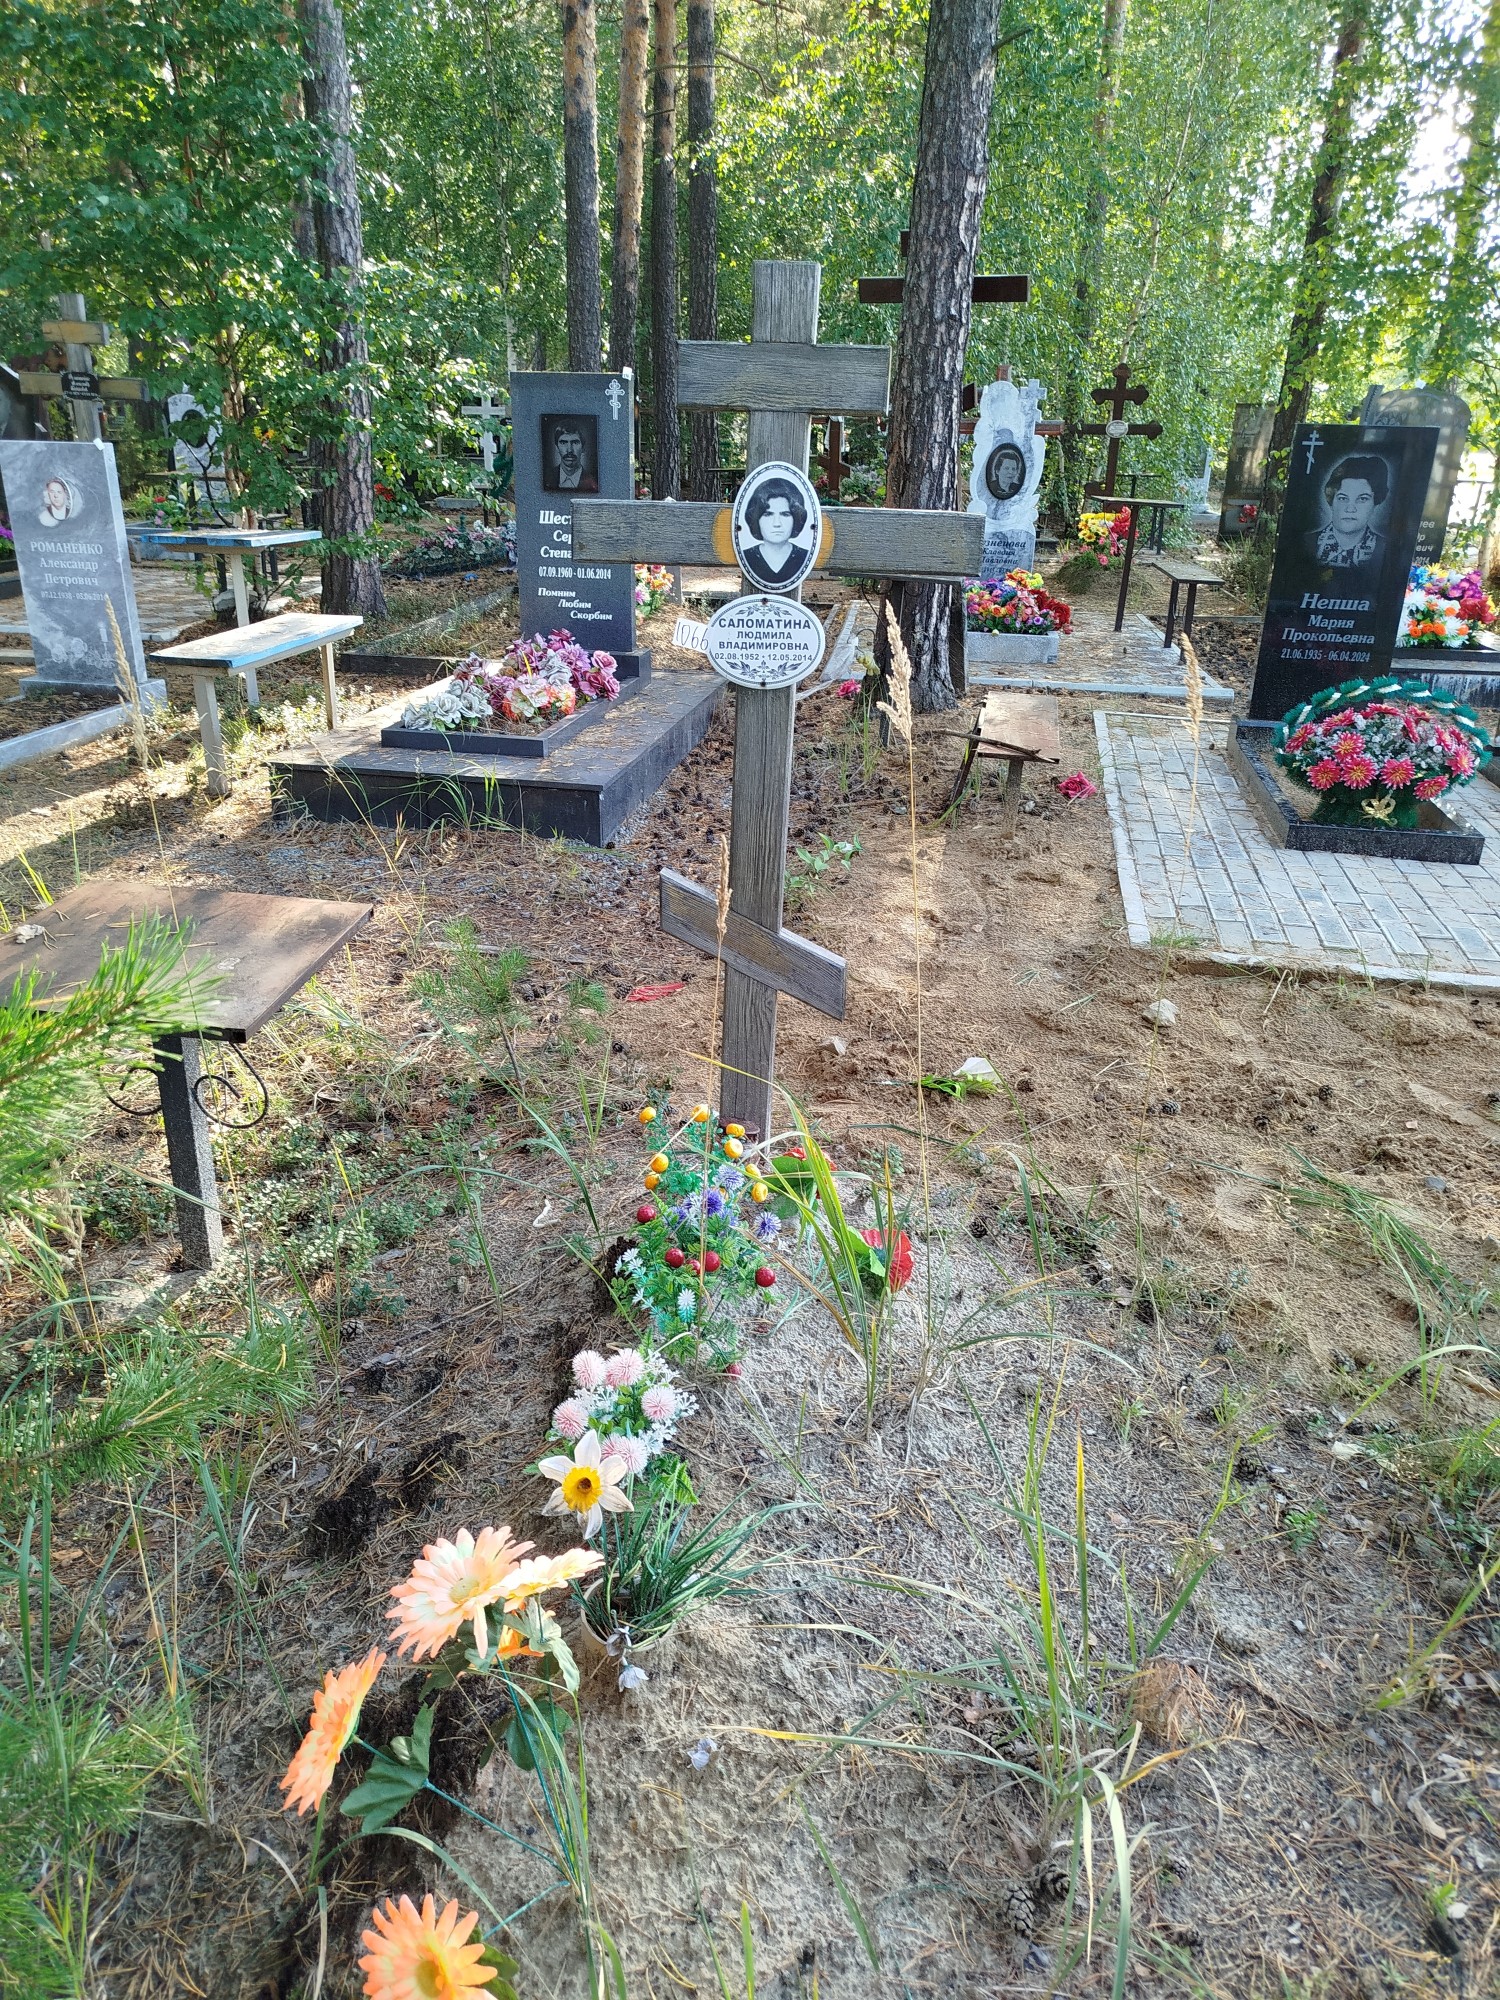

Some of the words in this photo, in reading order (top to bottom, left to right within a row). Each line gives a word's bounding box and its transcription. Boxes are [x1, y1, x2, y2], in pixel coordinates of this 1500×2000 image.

[30, 540, 103, 555] РОМАНЕЙКО
[40, 557, 99, 573] Александр
[538, 566, 573, 578] 07.09.1960
[577, 567, 612, 579] 01.06.2014
[44, 573, 100, 587] Петрович
[538, 587, 576, 598] Помним
[558, 599, 592, 609] Любим
[1300, 592, 1371, 611] Непша
[570, 610, 613, 621] Скорбим
[1308, 614, 1355, 630] Мария
[718, 618, 812, 630] САЛОМАТИНА
[676, 621, 709, 651] 1066
[736, 631, 793, 640] ЛЮДМИЛА
[1282, 627, 1376, 645] Прокопьевна
[718, 641, 810, 651] ВЛАДИМИРОВНА
[714, 652, 760, 661] 02.08.1952
[767, 653, 813, 662] 12.05.2014
[1280, 647, 1322, 660] 21.06.1935
[1328, 650, 1371, 663] 06.04.2024
